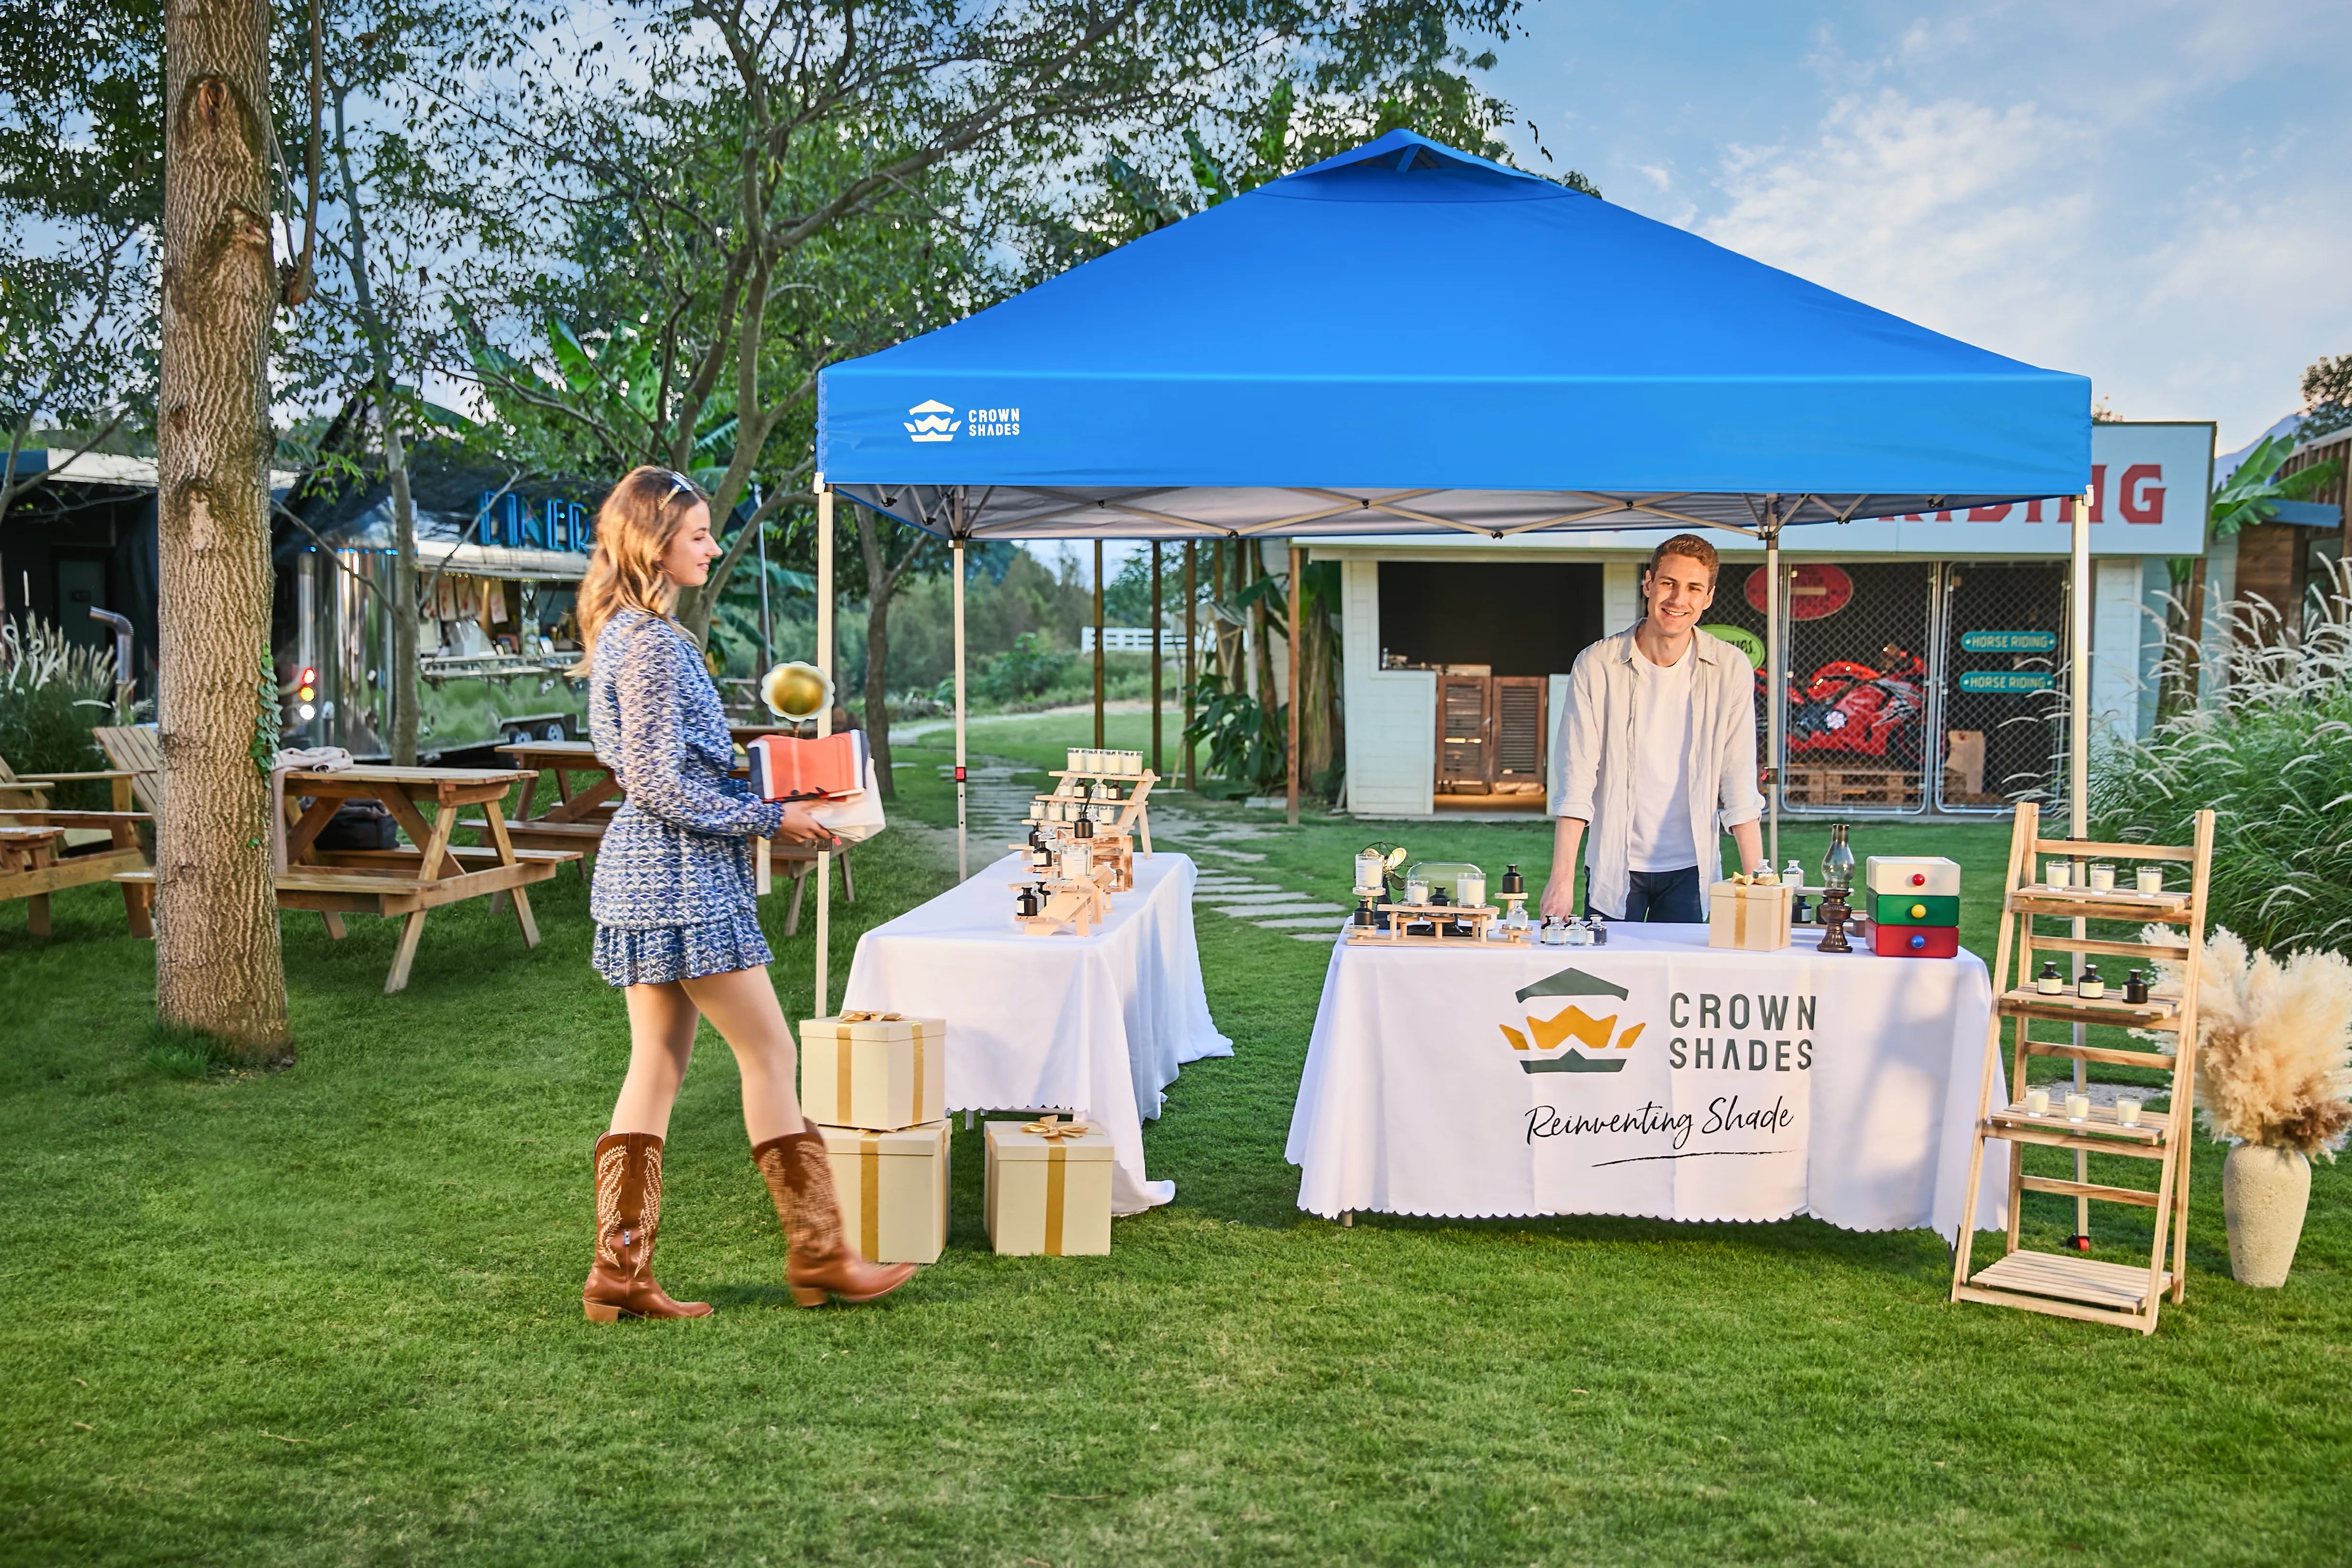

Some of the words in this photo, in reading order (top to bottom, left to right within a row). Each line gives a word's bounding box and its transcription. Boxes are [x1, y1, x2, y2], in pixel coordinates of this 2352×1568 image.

[968, 408, 1019, 423] CROWN
[969, 423, 1020, 436] SHADES
[1972, 635, 2008, 648] HORSE
[2011, 635, 2048, 648] RIDING
[1970, 676, 2006, 689] HORSE
[2009, 676, 2046, 689] RIDING
[1670, 992, 1816, 1031] CROWN
[1669, 1037, 1813, 1071] SHADES
[1525, 1101, 1693, 1149] Reinventing
[1702, 1095, 1794, 1134] Shade
